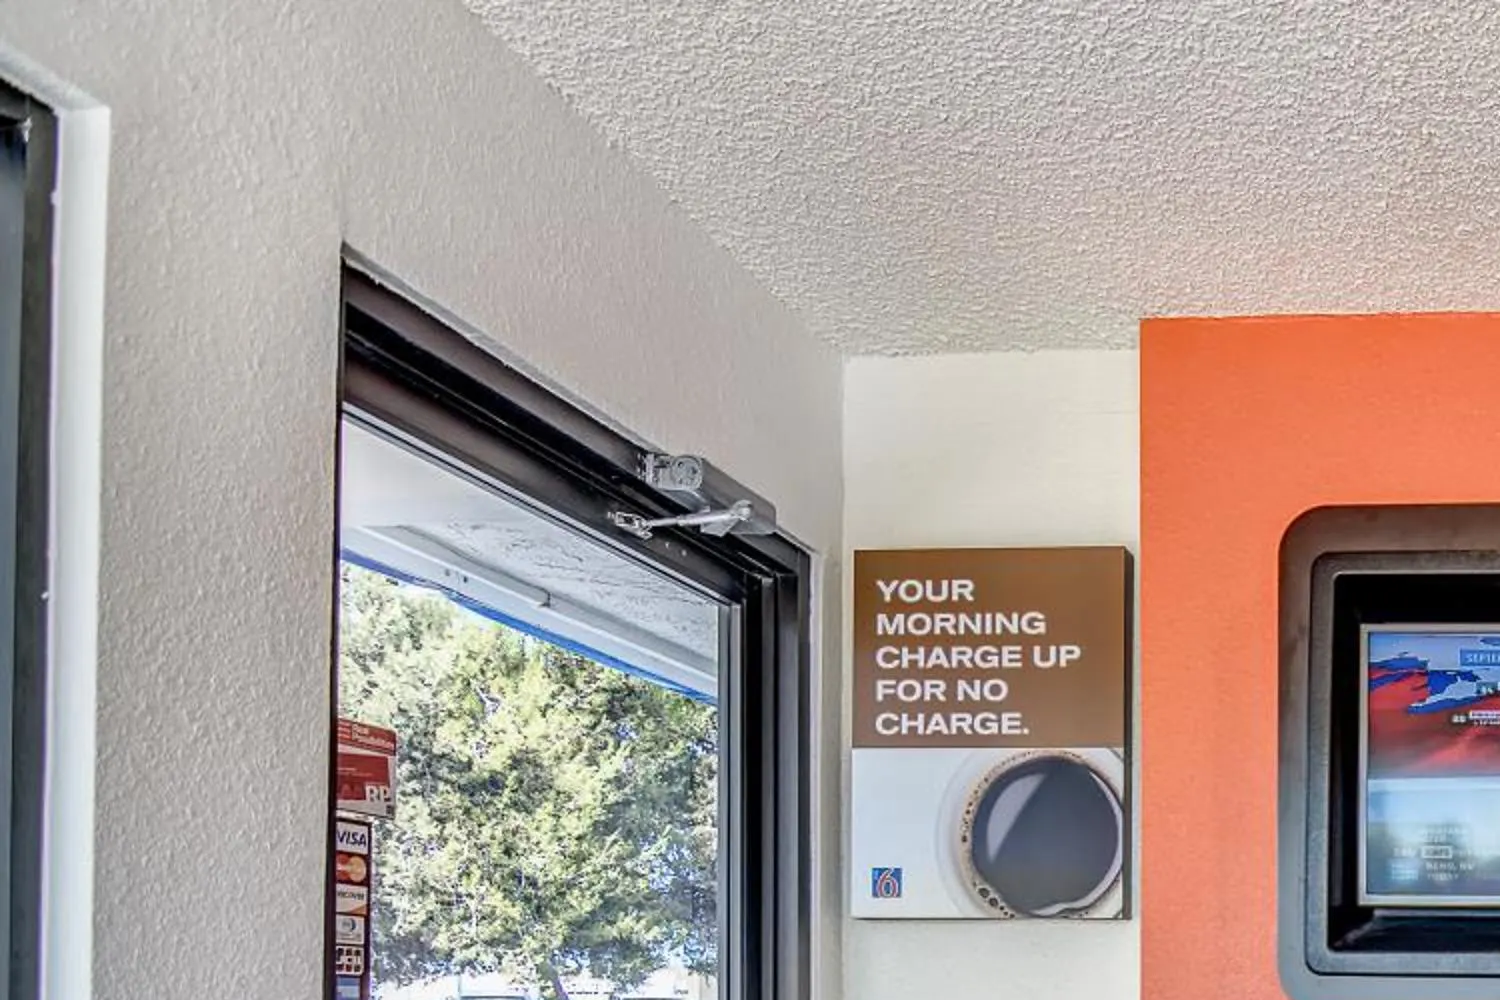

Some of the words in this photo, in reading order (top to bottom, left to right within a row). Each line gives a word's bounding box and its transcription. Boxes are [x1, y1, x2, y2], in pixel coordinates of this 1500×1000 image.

[876, 579, 975, 602] YOUR
[876, 612, 1047, 635] MORNING
[875, 645, 1023, 669] CHARGE
[1033, 645, 1082, 668] UP
[875, 679, 947, 702] FOR
[957, 679, 1009, 702] NO
[875, 712, 1030, 736] CHARGE.
[337, 831, 366, 846] VISA
